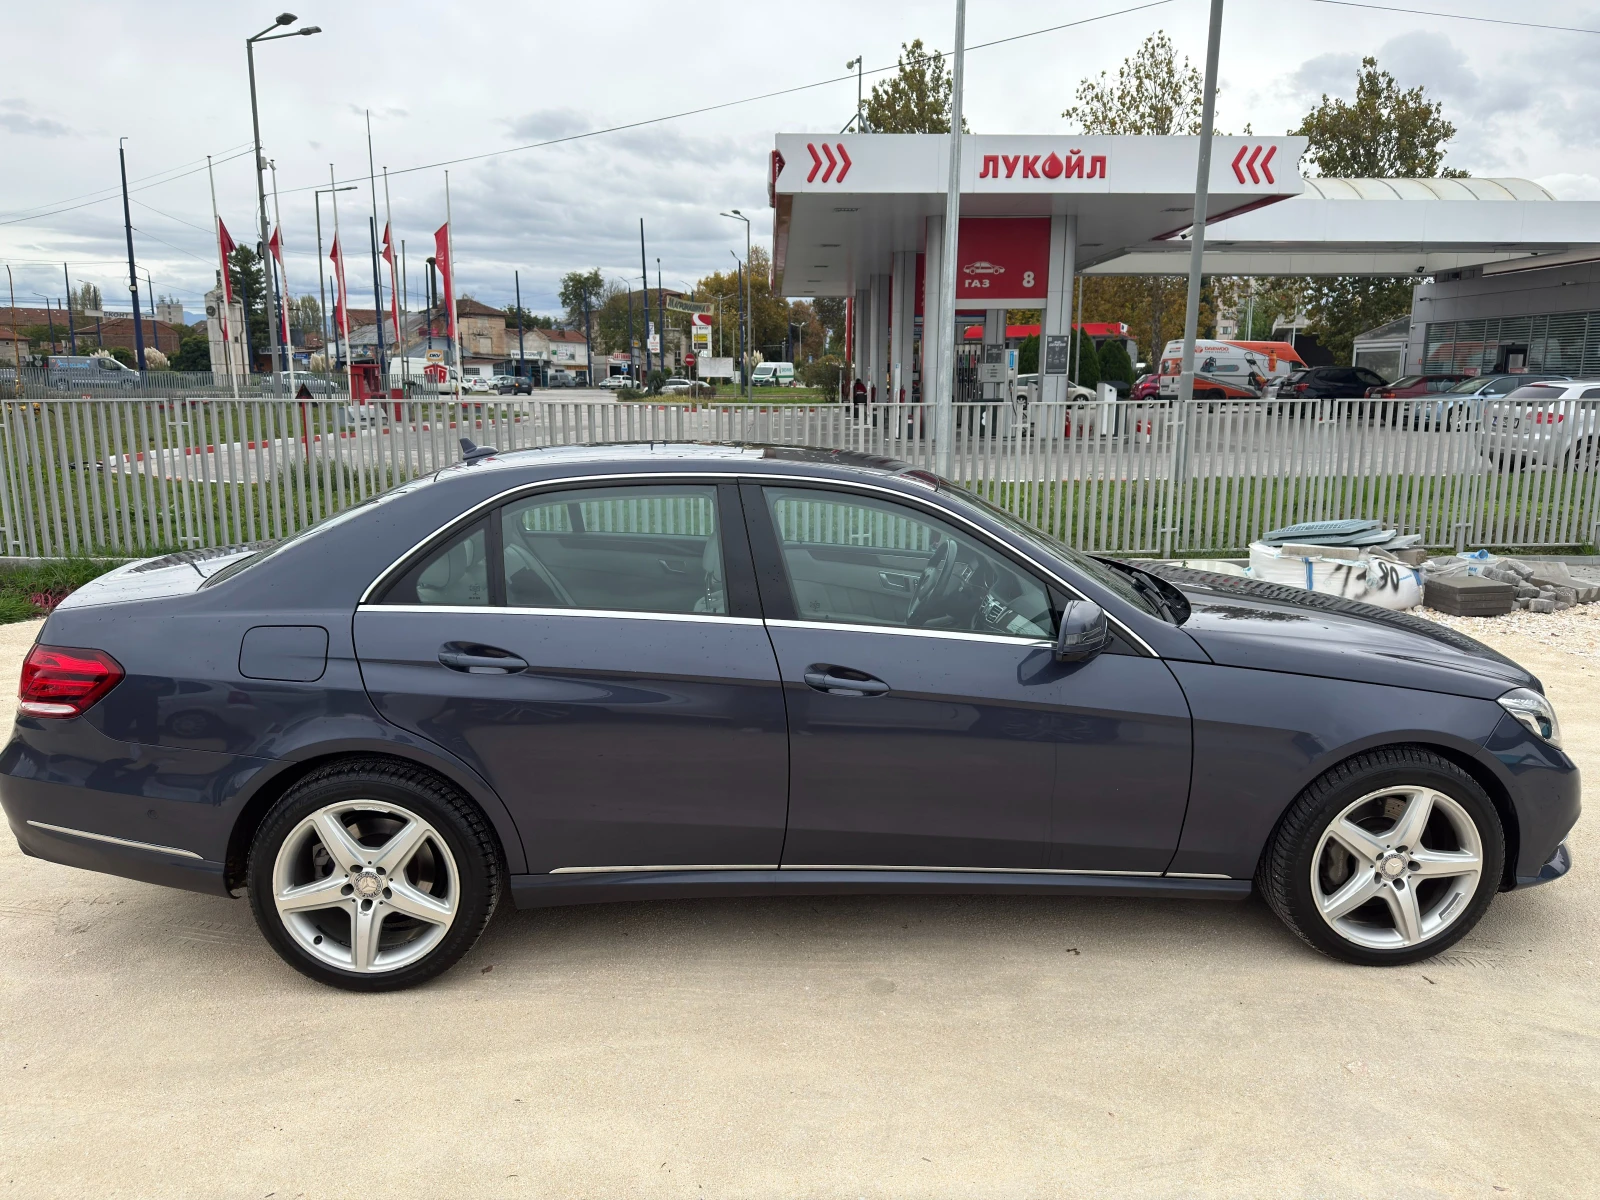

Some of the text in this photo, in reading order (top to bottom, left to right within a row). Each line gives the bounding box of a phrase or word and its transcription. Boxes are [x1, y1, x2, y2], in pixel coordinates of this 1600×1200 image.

[979, 148, 1106, 179] ЛУКОЙЛ
[964, 279, 990, 288] ГАЗ
[1022, 271, 1035, 288] 8
